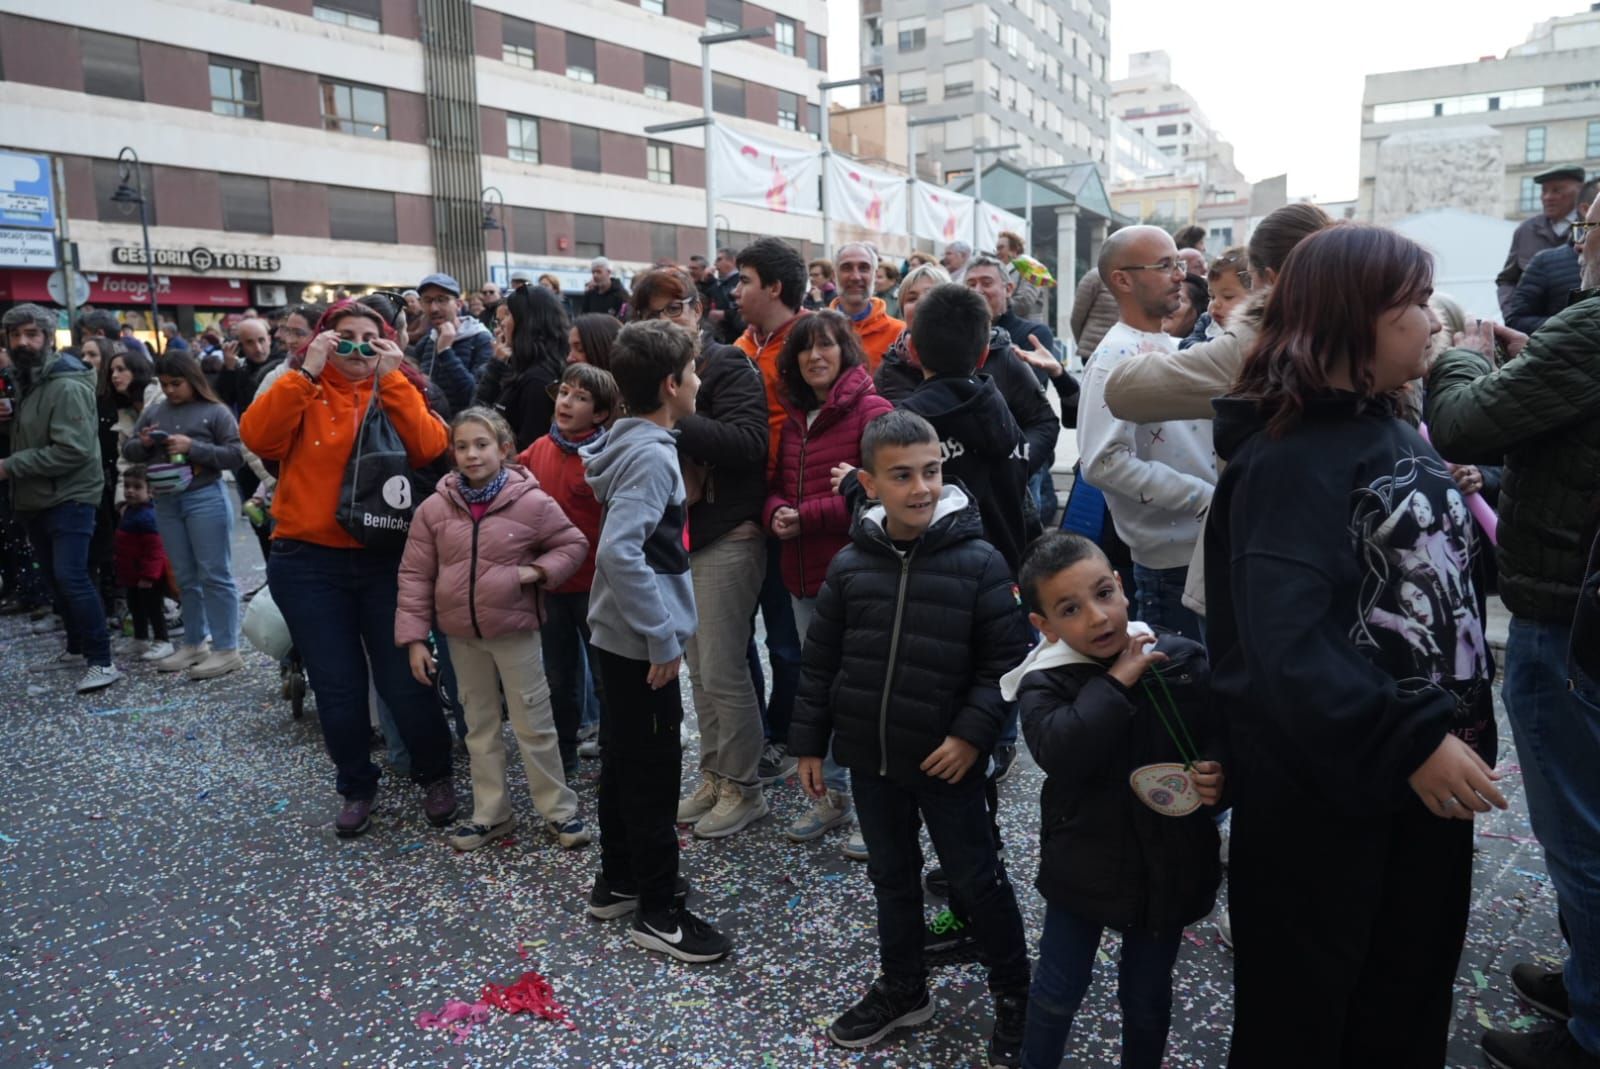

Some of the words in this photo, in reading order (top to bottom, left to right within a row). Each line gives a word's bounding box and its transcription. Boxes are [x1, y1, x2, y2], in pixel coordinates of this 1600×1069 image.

[117, 248, 192, 265] GESTORIA
[214, 254, 280, 270] TORRES
[102, 277, 170, 296] fotopix
